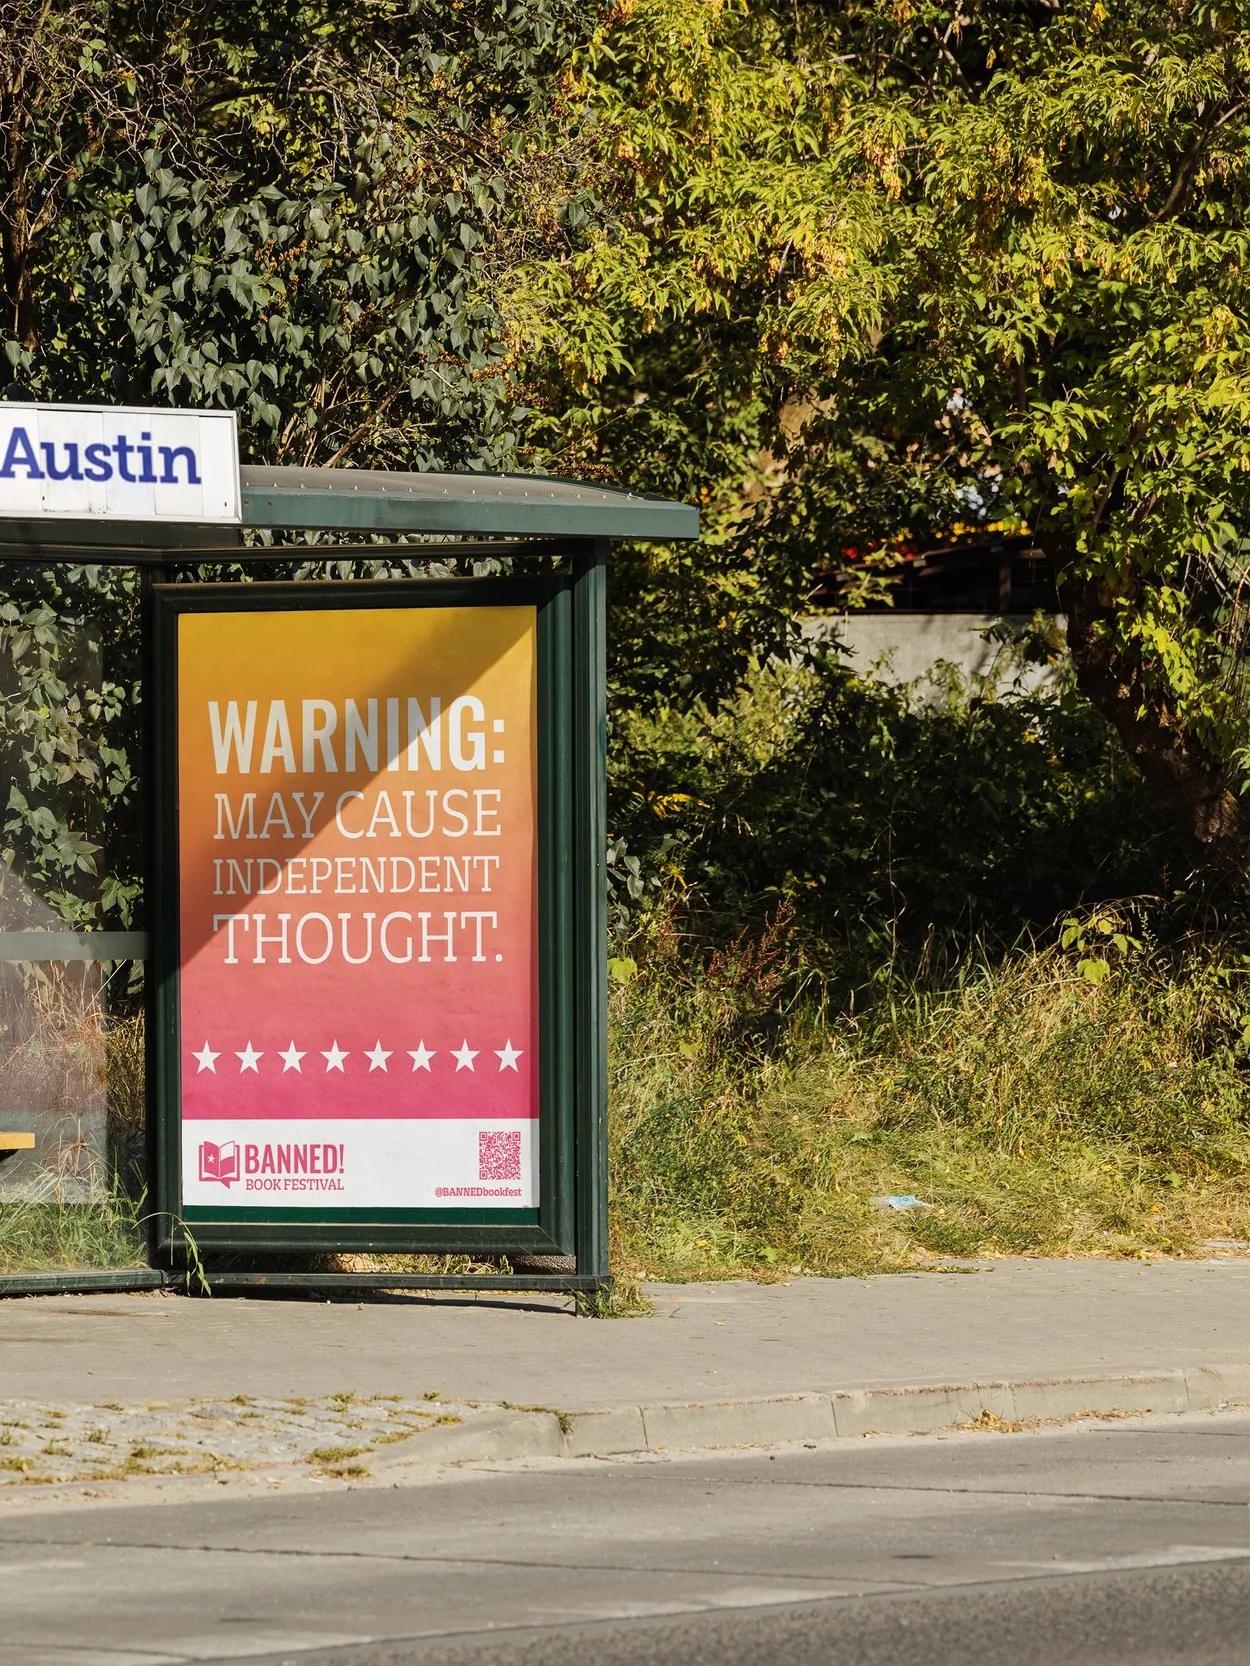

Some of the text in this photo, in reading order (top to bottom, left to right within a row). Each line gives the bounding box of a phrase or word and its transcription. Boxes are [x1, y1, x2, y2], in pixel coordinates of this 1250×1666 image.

[207, 694, 506, 775] WARNING:
[213, 788, 502, 840] MAY CAUSE
[212, 855, 500, 895] INDEPENDENT
[212, 911, 504, 964] THOUGHT.
[244, 1143, 345, 1174] BANNED!
[245, 1178, 345, 1191] BOOK FESTIVAL
[434, 1186, 522, 1198] @BANNEDbookfest
